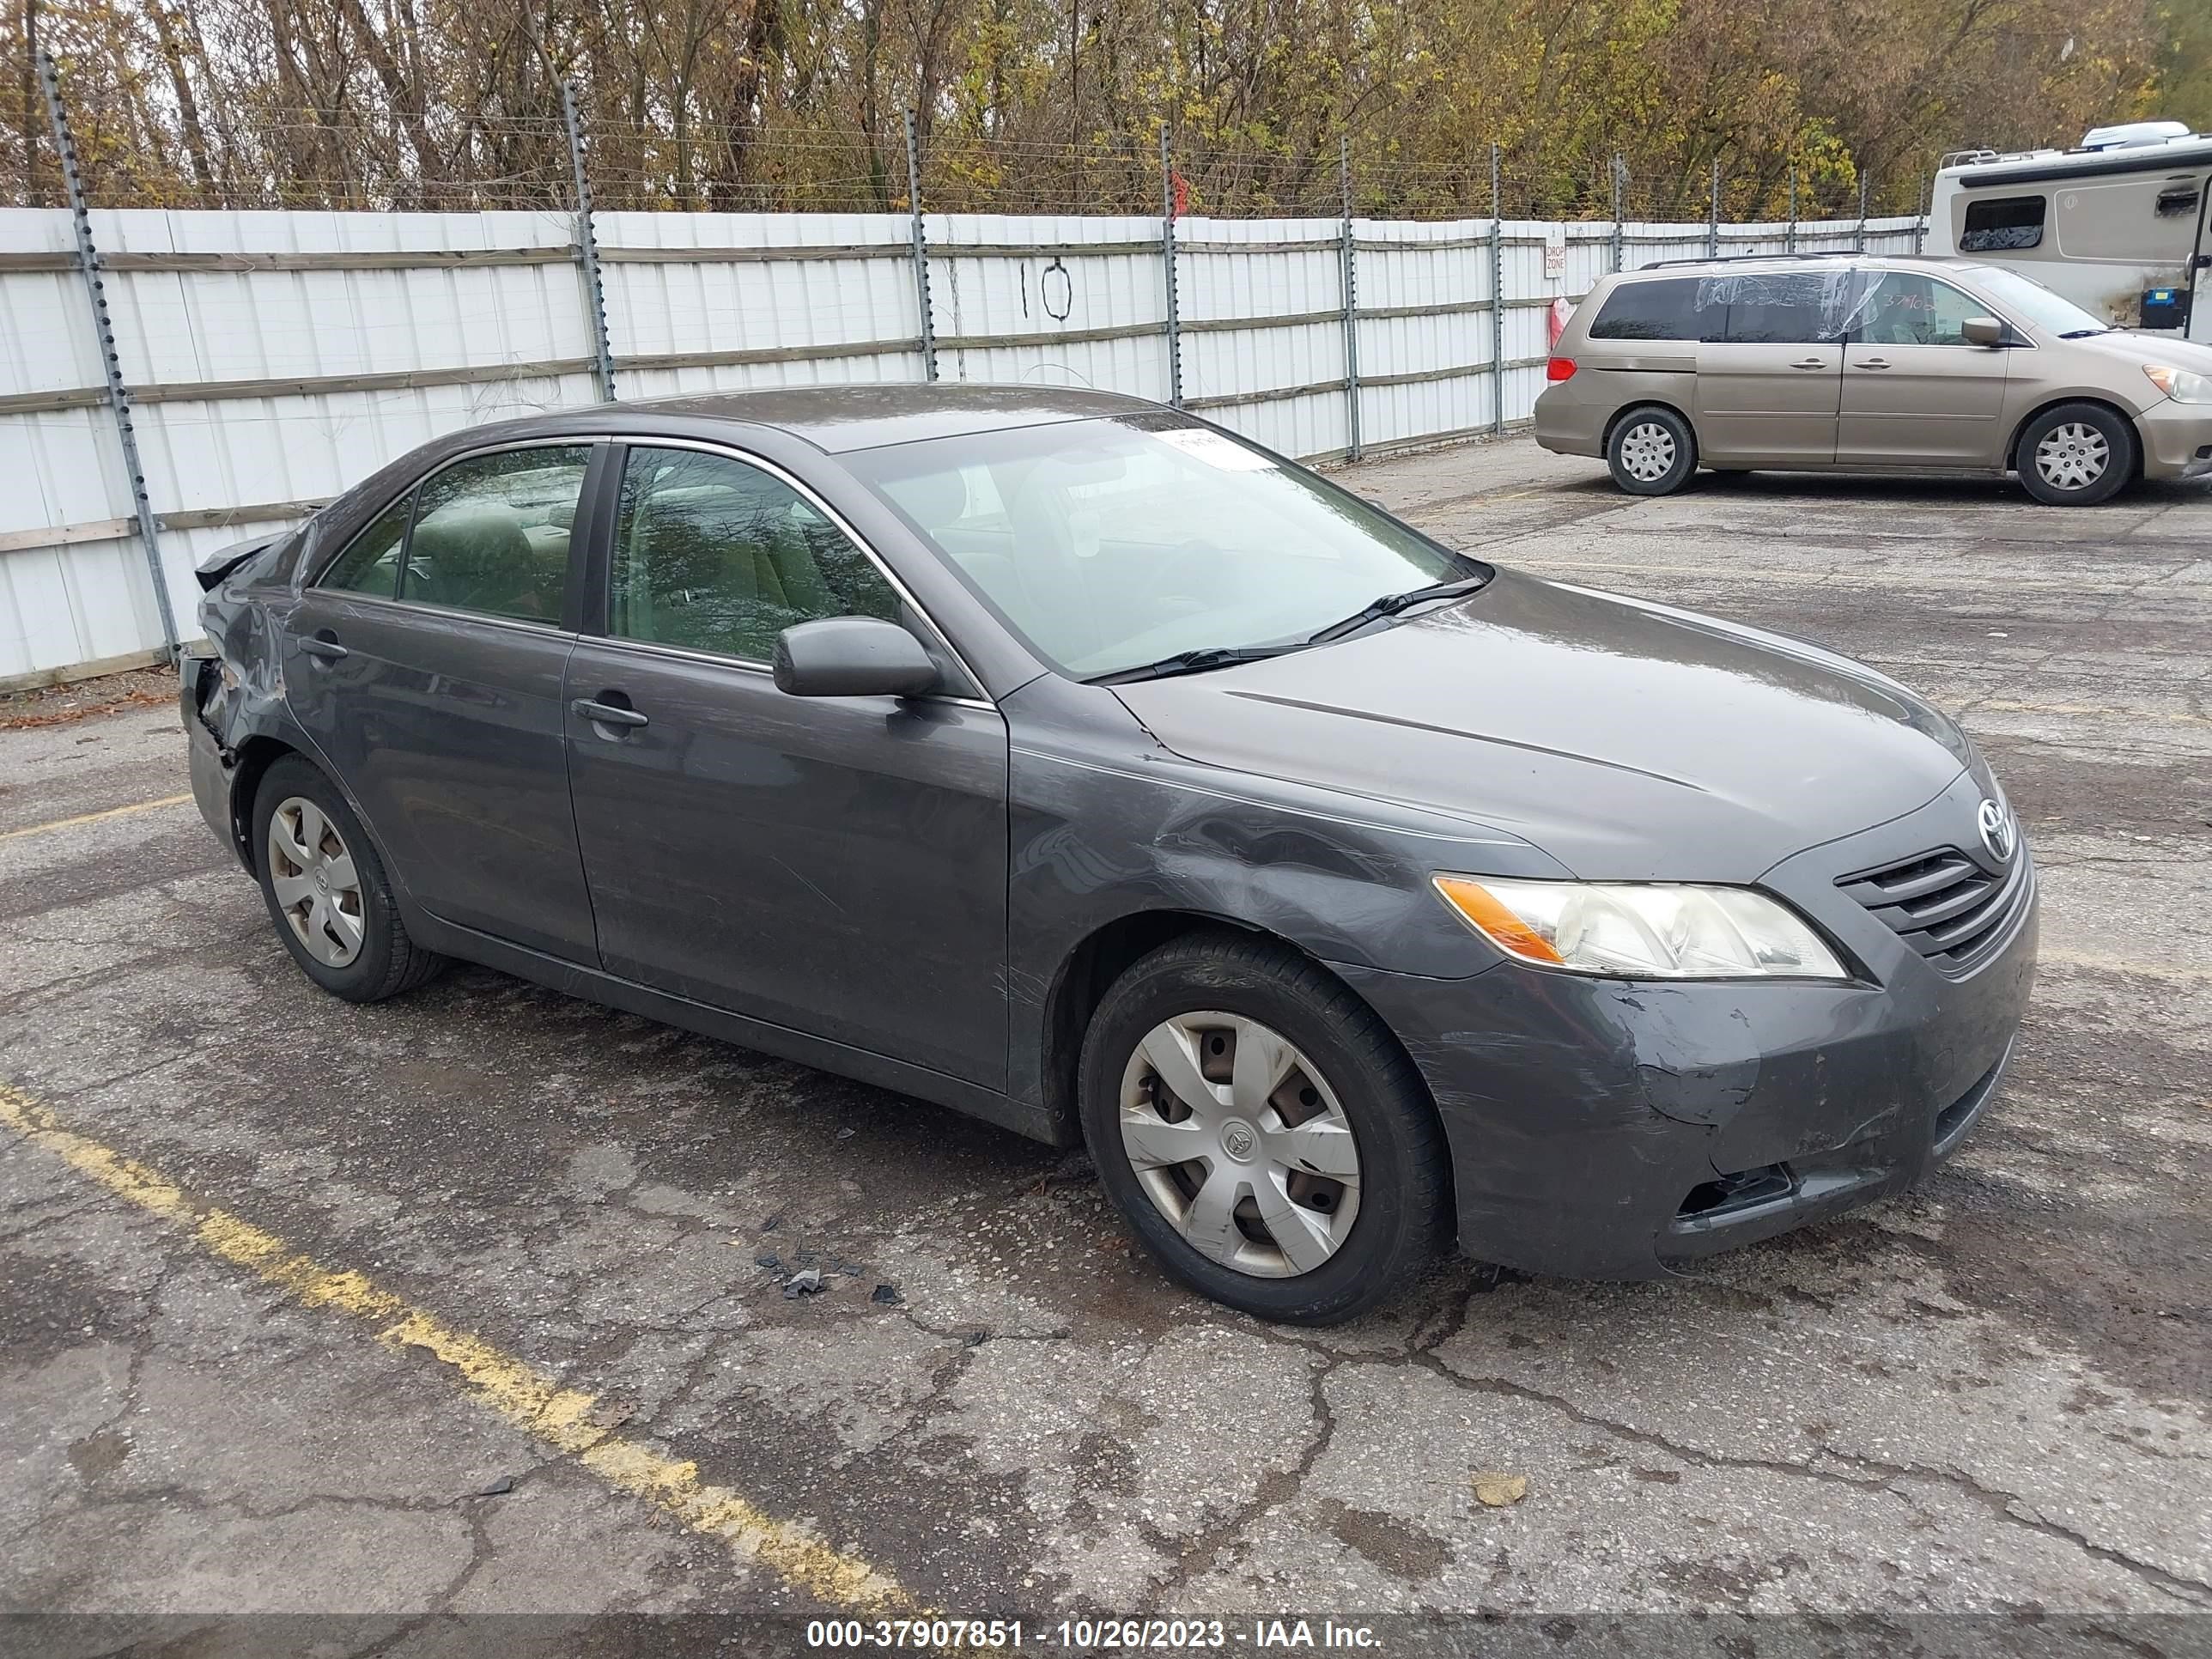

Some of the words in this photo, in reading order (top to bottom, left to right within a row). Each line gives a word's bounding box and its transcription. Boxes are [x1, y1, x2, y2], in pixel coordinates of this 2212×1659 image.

[1547, 246, 1564, 256] DROP
[1547, 258, 1564, 269] ZONE
[1020, 260, 1073, 323] 10
